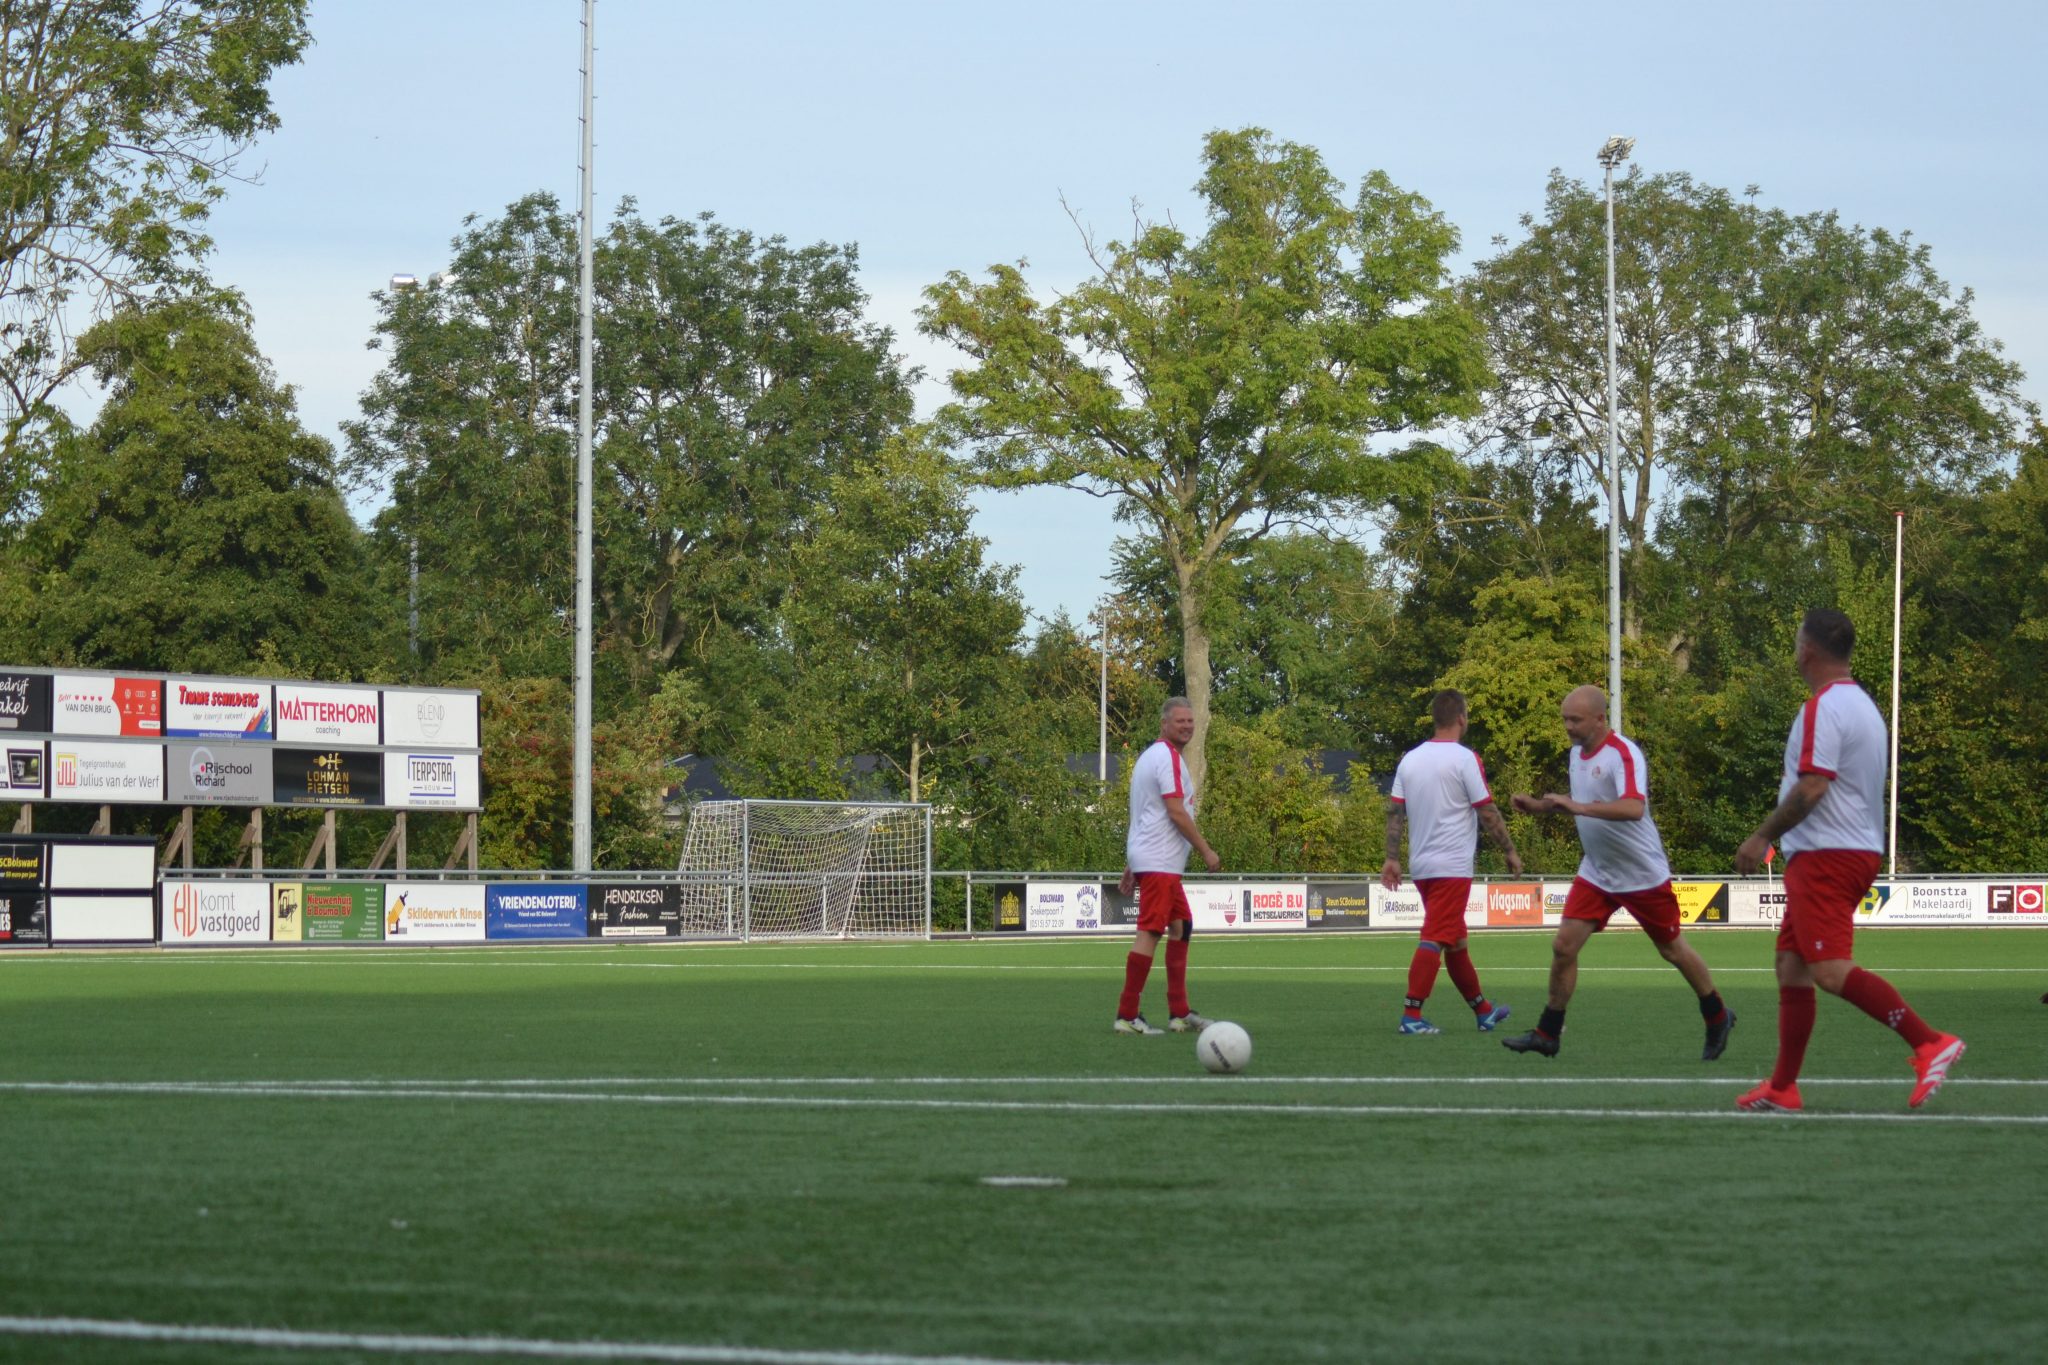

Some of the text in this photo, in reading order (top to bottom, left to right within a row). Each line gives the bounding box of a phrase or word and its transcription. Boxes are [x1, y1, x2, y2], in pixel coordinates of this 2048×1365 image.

[211, 691, 259, 708] SCHILDERS
[65, 703, 112, 714] VAN DEN BRUG
[279, 695, 376, 724] MATTERHORN
[417, 704, 446, 720] BLEND
[315, 726, 341, 736] coaching
[205, 762, 252, 776] Rijschool
[412, 761, 452, 782] TERPSTRA
[80, 773, 160, 788] Julius van der Werf
[195, 775, 226, 787] Richard
[307, 771, 350, 783] LOHMAN
[307, 783, 350, 795] FIETSEN
[605, 888, 664, 905] HENDRIKSEN
[1912, 886, 1967, 897] Boonstra
[200, 889, 236, 911] komt
[307, 893, 353, 905] Nieuwenhuis
[498, 895, 577, 910] VRIENDENLOTERIJ
[1039, 894, 1065, 903] BOLSWARD
[1286, 894, 1304, 908] B.V.
[1489, 888, 1531, 916] vlagsma
[1912, 898, 1972, 911] Makelaardij
[407, 907, 483, 920] Skilderwurk Rinse
[619, 905, 649, 923] Fashion
[1030, 906, 1065, 917] Snekerpoort 7
[1253, 910, 1304, 920] METSELWERKEN
[200, 909, 260, 937] vastgoed
[1075, 919, 1099, 929] FISH CHIPS
